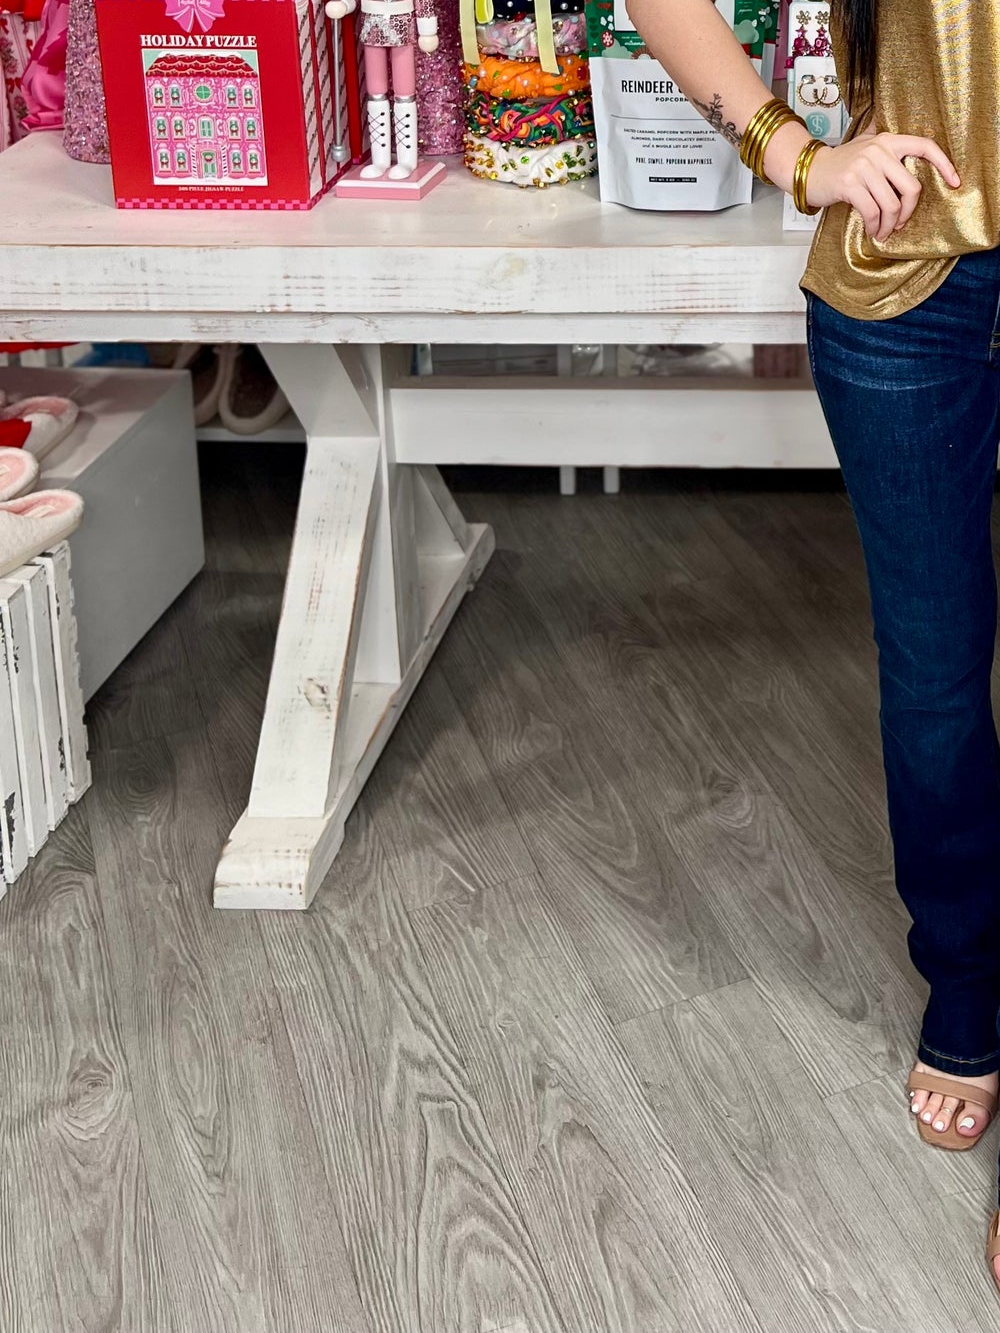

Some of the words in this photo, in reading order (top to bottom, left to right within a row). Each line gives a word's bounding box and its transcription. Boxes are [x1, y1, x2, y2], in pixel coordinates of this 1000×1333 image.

[140, 34, 206, 47] HOLIDAY
[205, 35, 258, 48] PUZZLE
[621, 79, 674, 94] REINDEER
